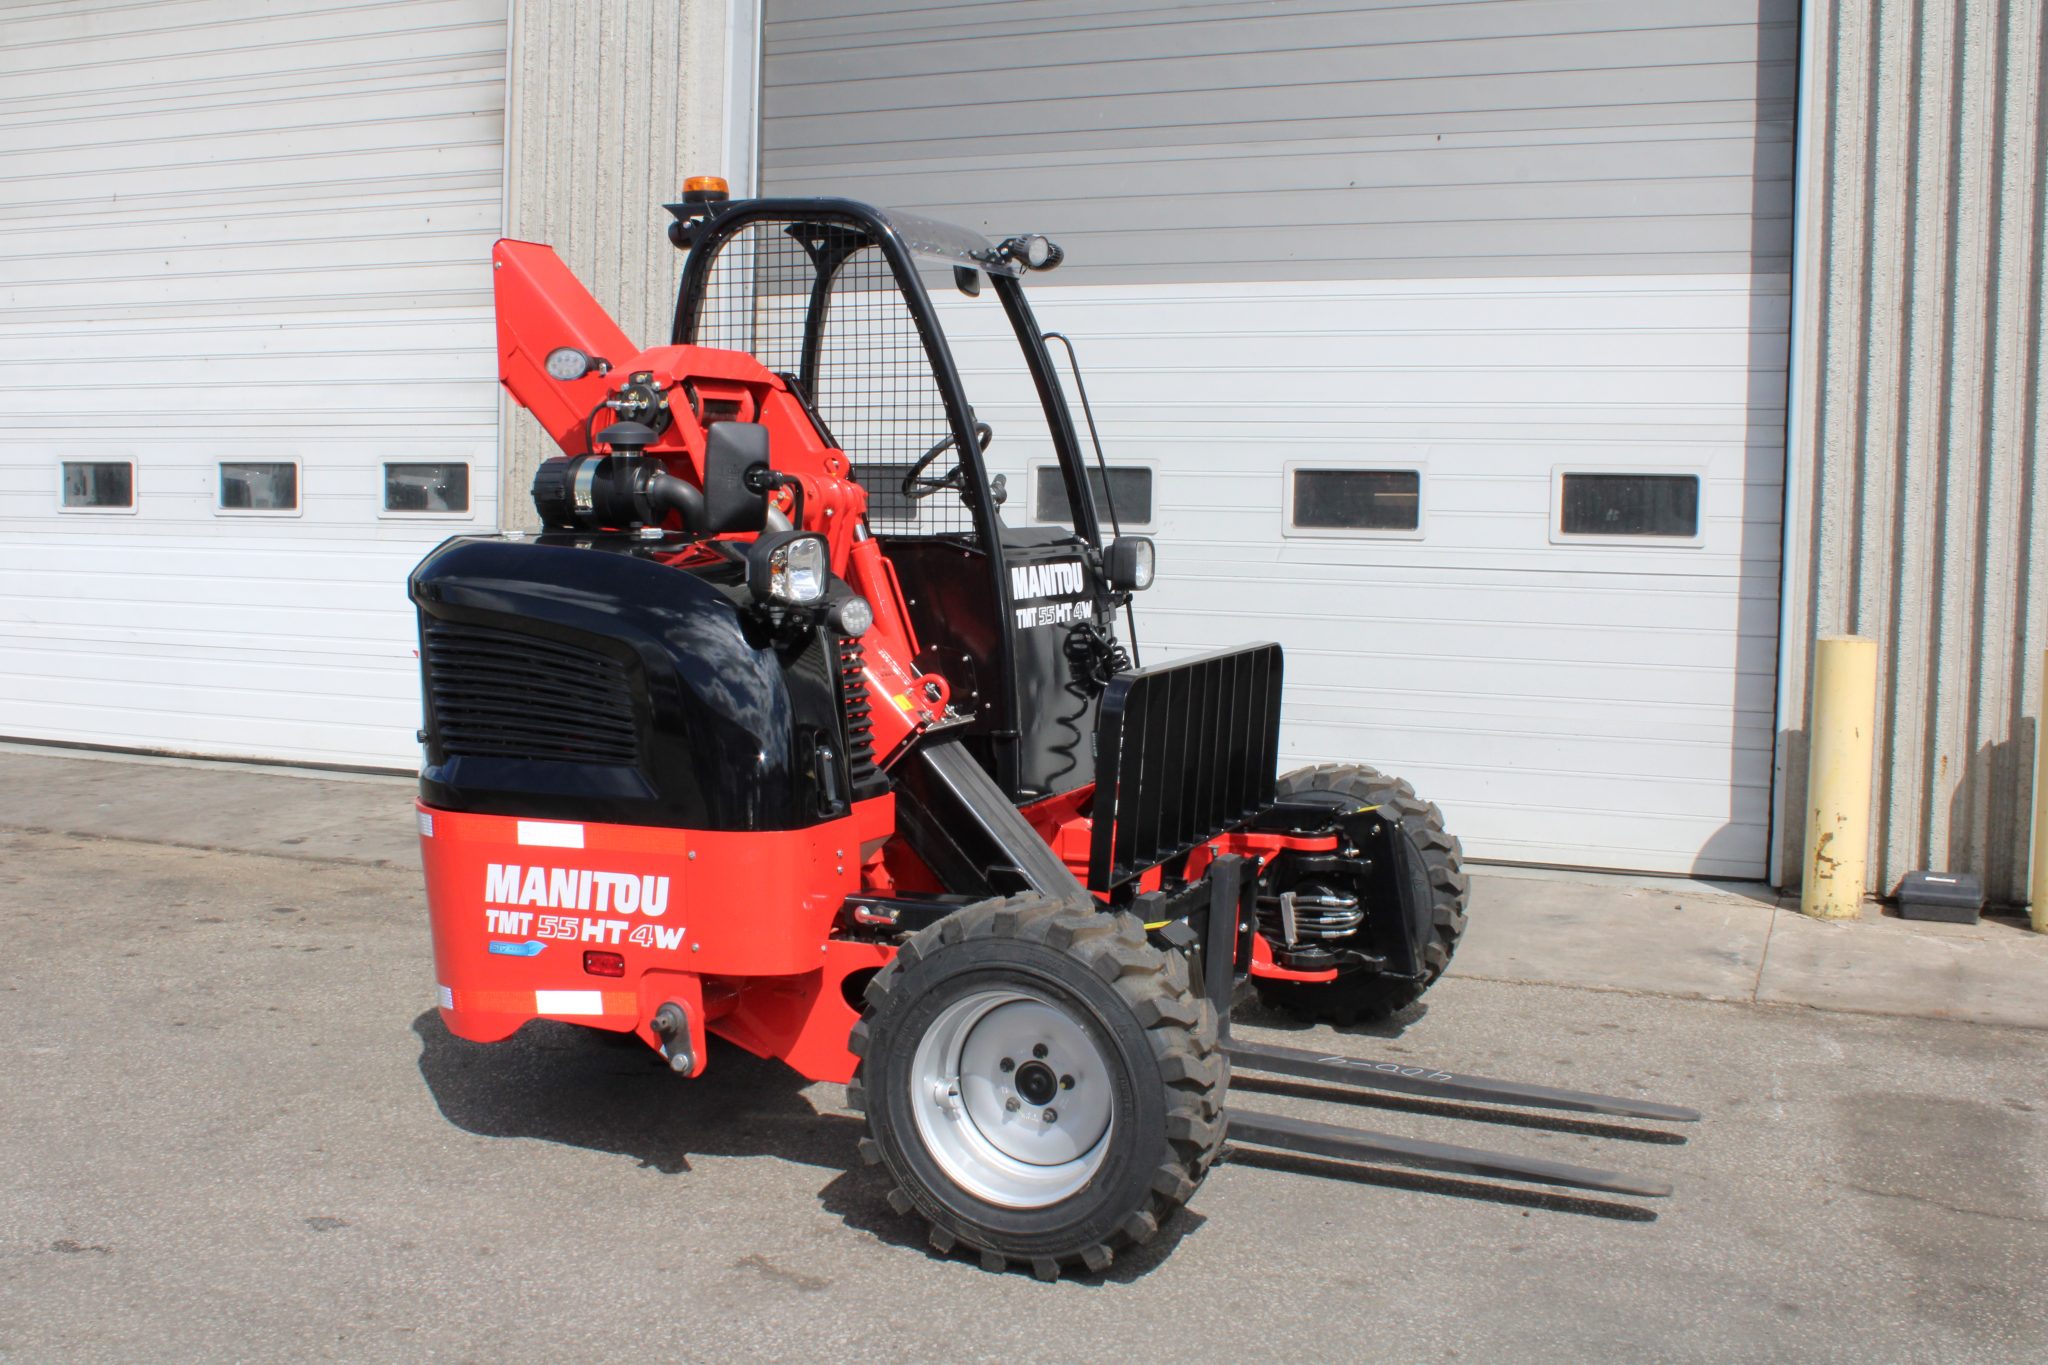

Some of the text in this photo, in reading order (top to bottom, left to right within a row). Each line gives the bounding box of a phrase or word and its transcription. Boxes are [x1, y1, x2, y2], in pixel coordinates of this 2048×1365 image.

[1011, 562, 1084, 600] MANITOU
[1016, 607, 1037, 629] TMT
[485, 863, 670, 917] MANITOU
[485, 909, 534, 936] TMT
